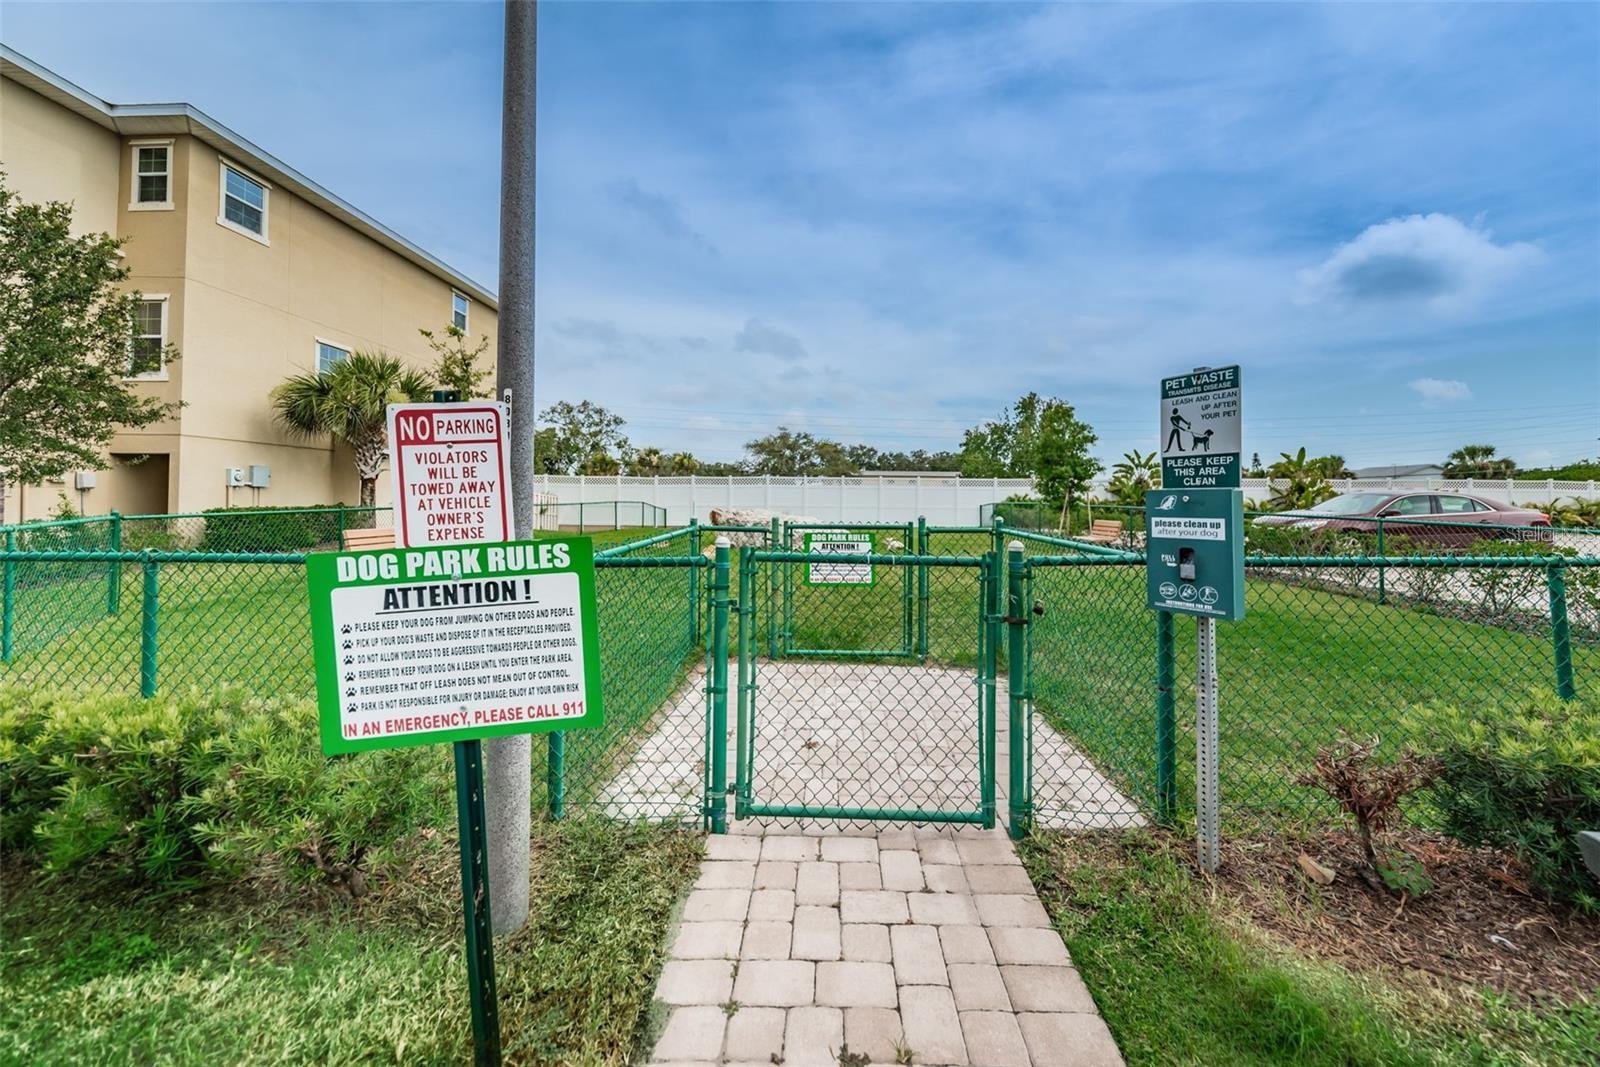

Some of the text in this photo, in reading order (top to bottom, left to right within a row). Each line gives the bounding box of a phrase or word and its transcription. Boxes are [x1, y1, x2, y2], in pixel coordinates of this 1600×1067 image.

[1166, 369, 1233, 390] PET WASTE
[1168, 381, 1231, 396] TRANSMITS DISEASE
[1172, 397, 1193, 405] LEASH
[1213, 391, 1237, 400] CLEAN
[400, 416, 493, 440] NO PARKING
[415, 450, 488, 464] VIOLATORS
[1167, 456, 1233, 467] PLEASE KEEP
[428, 466, 477, 479] WILL BE
[1174, 467, 1226, 476] THIS AREA
[411, 481, 495, 496] TOWED AWAY
[1184, 477, 1215, 485] CLEAN
[418, 496, 491, 511] AT VEHICLE
[427, 512, 484, 526] OWNER'S
[428, 527, 484, 541] EXPENSE
[337, 543, 571, 582] DOG PARK RULES
[383, 579, 531, 610] ATTENTION !
[355, 607, 575, 632] PLEASE KEEP YOUR DOG FROM JUMPING ON OTHER DOGS AND PEOPLE.
[356, 623, 572, 648] PICK UP YOUR DOG'S WASTE AND DISPOSE OF IT IN THE RECEPTACLES PROVIDED.
[358, 638, 577, 663] DO NOT ALLOW YOUR DOGS TO BE AGGRESSIVE TOWARDS PEOPLE OR OTHER DOGS.
[358, 668, 390, 679] REMEMBER
[392, 668, 399, 676] TO
[401, 666, 416, 676] KEEP
[418, 665, 432, 674] YOUR
[434, 664, 446, 673] DOG
[447, 663, 455, 671] ON
[462, 661, 480, 670] LEASH
[481, 660, 497, 669] UNTIL
[498, 658, 509, 667] YOU
[511, 657, 528, 667] ENTER
[530, 656, 540, 664] THE
[542, 654, 555, 663] PARK
[557, 654, 573, 662] AREA.
[360, 669, 570, 695] REMEMBER THAT OFF LEASH DOES NOT MEAN OUT OF CONTROL.
[361, 702, 377, 711] PARK
[378, 701, 383, 709] IS
[385, 700, 397, 708] NOT
[399, 696, 438, 707] RESPONSIBLE
[439, 695, 450, 704] FOR
[452, 693, 472, 702] INJURY
[474, 692, 481, 700] OR
[509, 688, 527, 697] ENJOY
[528, 686, 534, 695] AT
[537, 685, 551, 694] YOUR
[552, 684, 565, 693] OWN
[566, 683, 579, 692] RISK
[344, 702, 584, 737] IN AN EMERGENCY, PLEASE CALL 911
